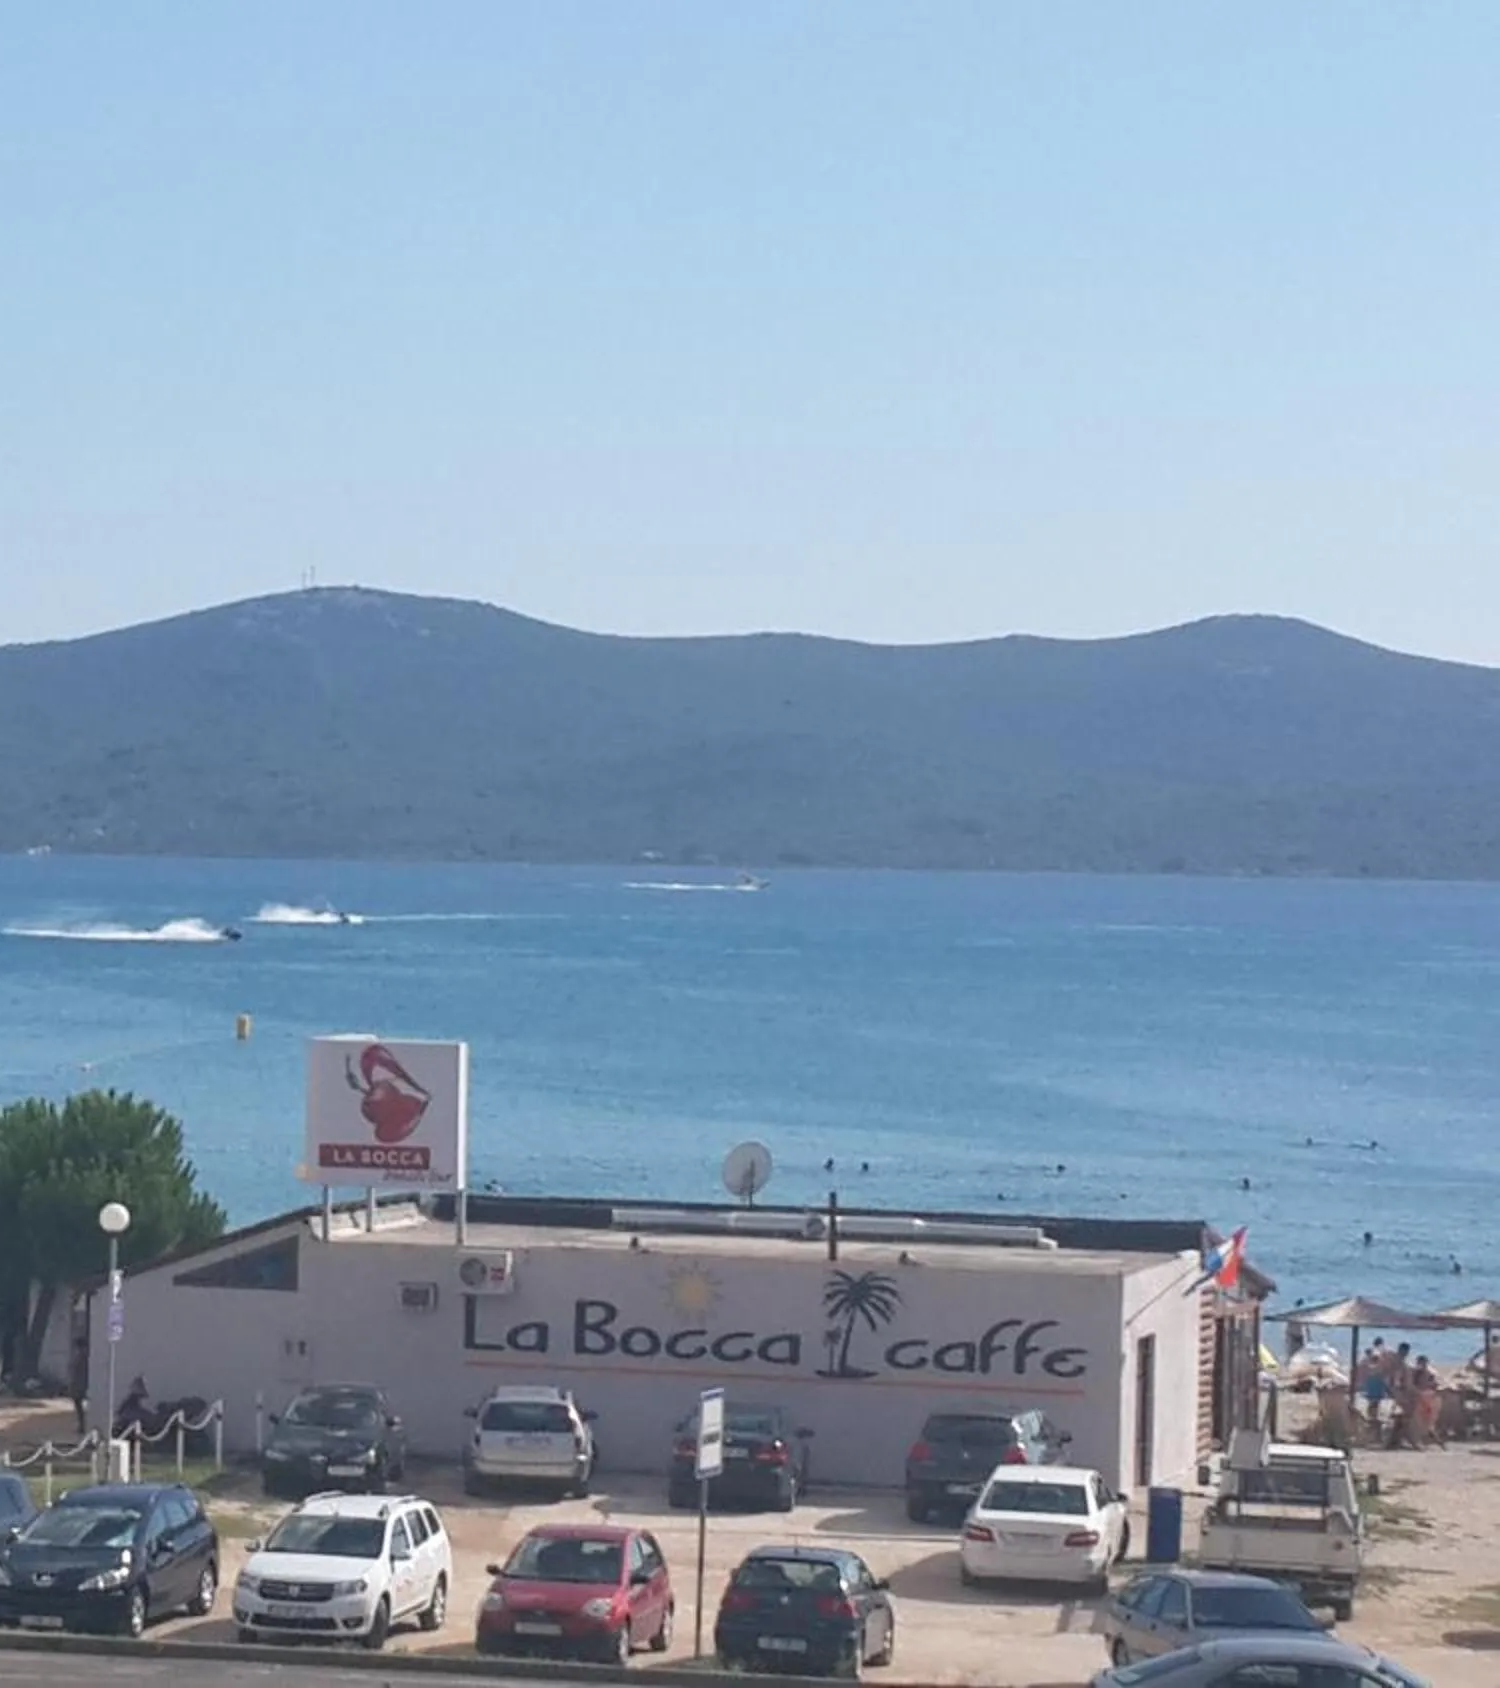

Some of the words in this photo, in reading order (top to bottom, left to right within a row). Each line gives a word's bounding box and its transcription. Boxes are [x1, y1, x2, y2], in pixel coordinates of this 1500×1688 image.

[333, 1148, 356, 1164] LA
[361, 1149, 423, 1166] BOCCA
[463, 1295, 549, 1353] La
[574, 1298, 802, 1366] Bocca
[884, 1319, 1088, 1378] caffe
